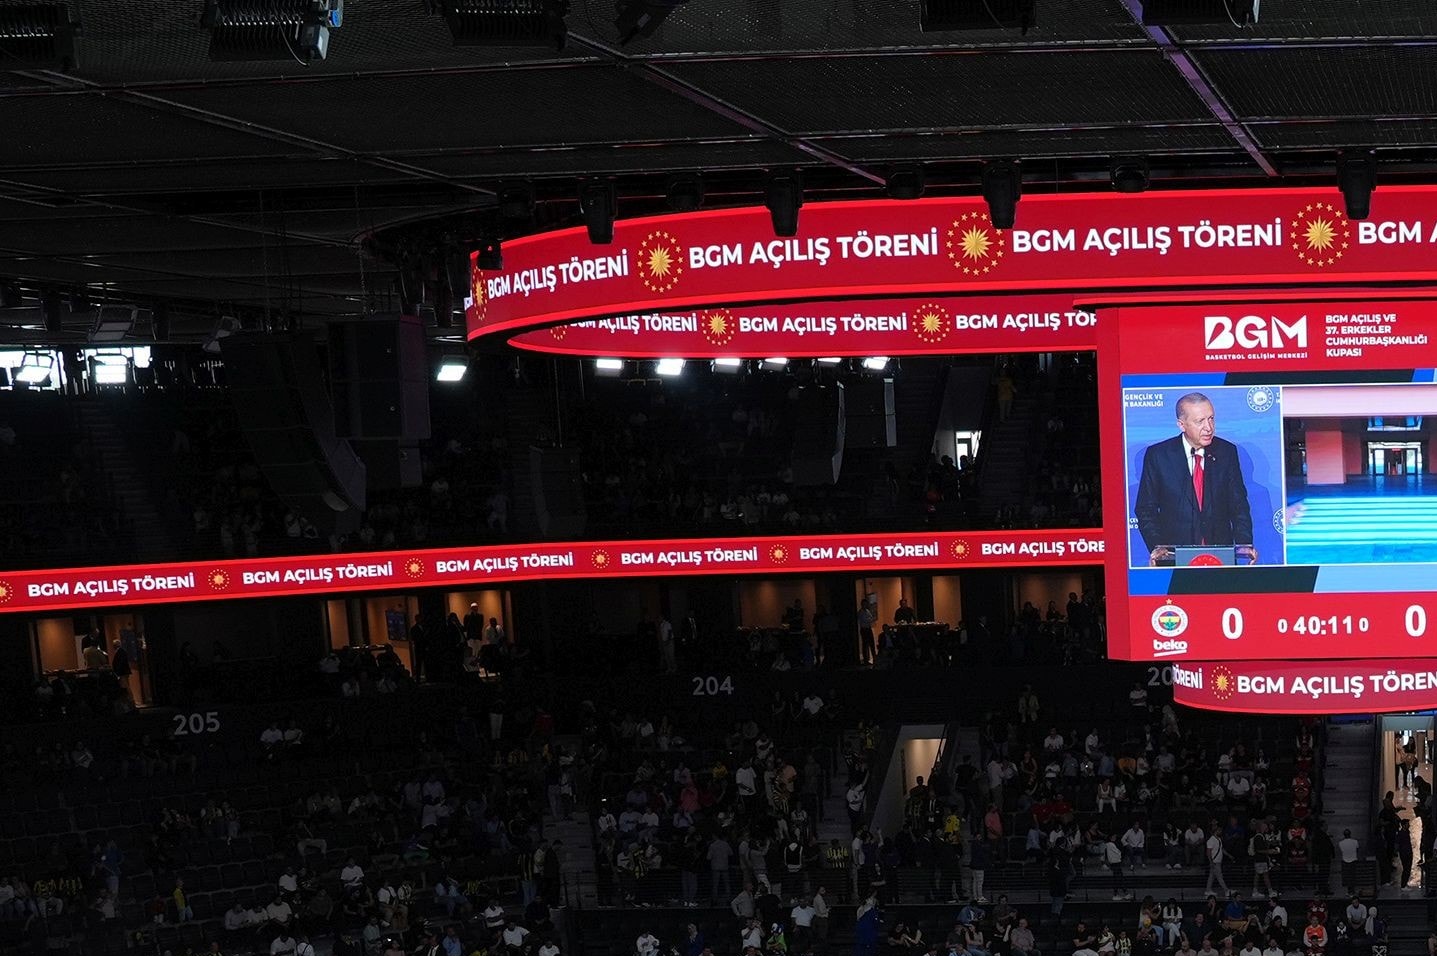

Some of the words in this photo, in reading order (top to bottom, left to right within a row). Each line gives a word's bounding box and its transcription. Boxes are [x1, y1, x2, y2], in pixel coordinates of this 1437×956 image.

[1012, 228, 1076, 253] BGM
[1082, 226, 1172, 257] AÇILIŞ
[1177, 217, 1282, 248] TÖRENİ
[1358, 220, 1422, 244] BGM
[689, 243, 743, 269] BGM
[749, 237, 831, 269] AÇILIŞ
[835, 226, 938, 259] TÖRENİ
[487, 274, 511, 300] BGM
[513, 265, 557, 297] AÇILIŞ
[558, 249, 629, 284] TÖRENİ
[739, 316, 778, 333] BGM
[781, 316, 838, 336] AÇILIŞ
[839, 312, 908, 332] TÖRENİ
[955, 314, 998, 330] BGM
[1002, 312, 1061, 332] AÇILIŞ
[1325, 314, 1348, 323] BGM
[1349, 314, 1381, 325] AÇILIŞ
[1383, 313, 1396, 322] VE
[1325, 326, 1340, 334] 37.
[1341, 325, 1391, 334] ERKEKLER
[1204, 314, 1308, 350] BGM
[1325, 334, 1428, 347] CUMHURBAŞKANLIĞI
[1326, 348, 1362, 357] KUPASI
[621, 552, 654, 565] BGM
[656, 550, 703, 567] AÇILIŞ
[703, 546, 758, 562] TÖRENİ
[799, 547, 833, 560] BGM
[836, 545, 883, 562] AÇILIŞ
[884, 541, 939, 557] TÖRENİ
[981, 542, 1016, 555] BGM
[1018, 541, 1066, 557] AÇILIŞ
[242, 570, 280, 585] BGM
[283, 567, 334, 585] AÇILIŞ
[335, 560, 393, 579] TÖRENİ
[436, 559, 470, 573] BGM
[472, 556, 519, 573] AÇILIŞ
[520, 551, 574, 568] TÖRENİ
[27, 582, 70, 597] BGM
[73, 579, 129, 597] AÇILIŞ
[131, 572, 195, 591] TÖRENİ
[1221, 607, 1244, 640] 0
[1277, 618, 1288, 633] 0
[1292, 616, 1352, 635] 40:11
[1358, 617, 1369, 632] 0
[1404, 604, 1427, 637] 0
[1153, 639, 1188, 651] beko
[692, 675, 735, 697] 204
[1237, 675, 1285, 694] BGM
[1290, 675, 1365, 699] AÇILIŞ
[172, 711, 221, 736] 205
